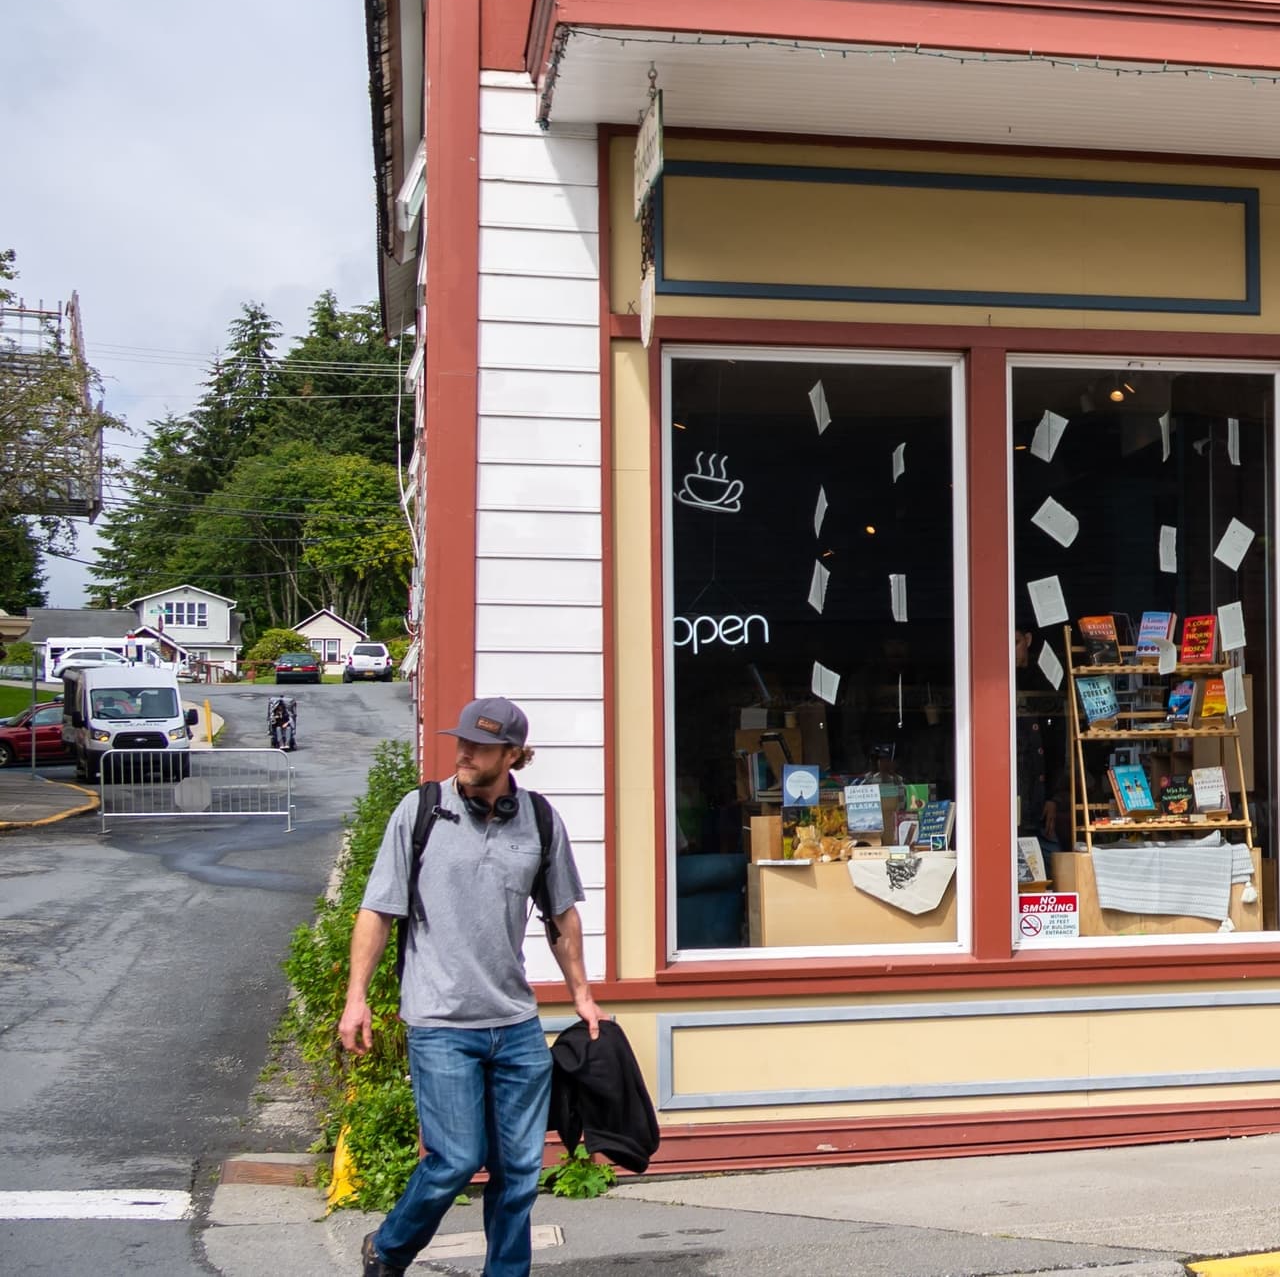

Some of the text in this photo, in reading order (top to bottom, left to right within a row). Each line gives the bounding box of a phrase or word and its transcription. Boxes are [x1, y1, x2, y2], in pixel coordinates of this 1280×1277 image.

[673, 614, 769, 655] open
[1040, 896, 1056, 904] NO
[1022, 903, 1074, 913] SMOKING
